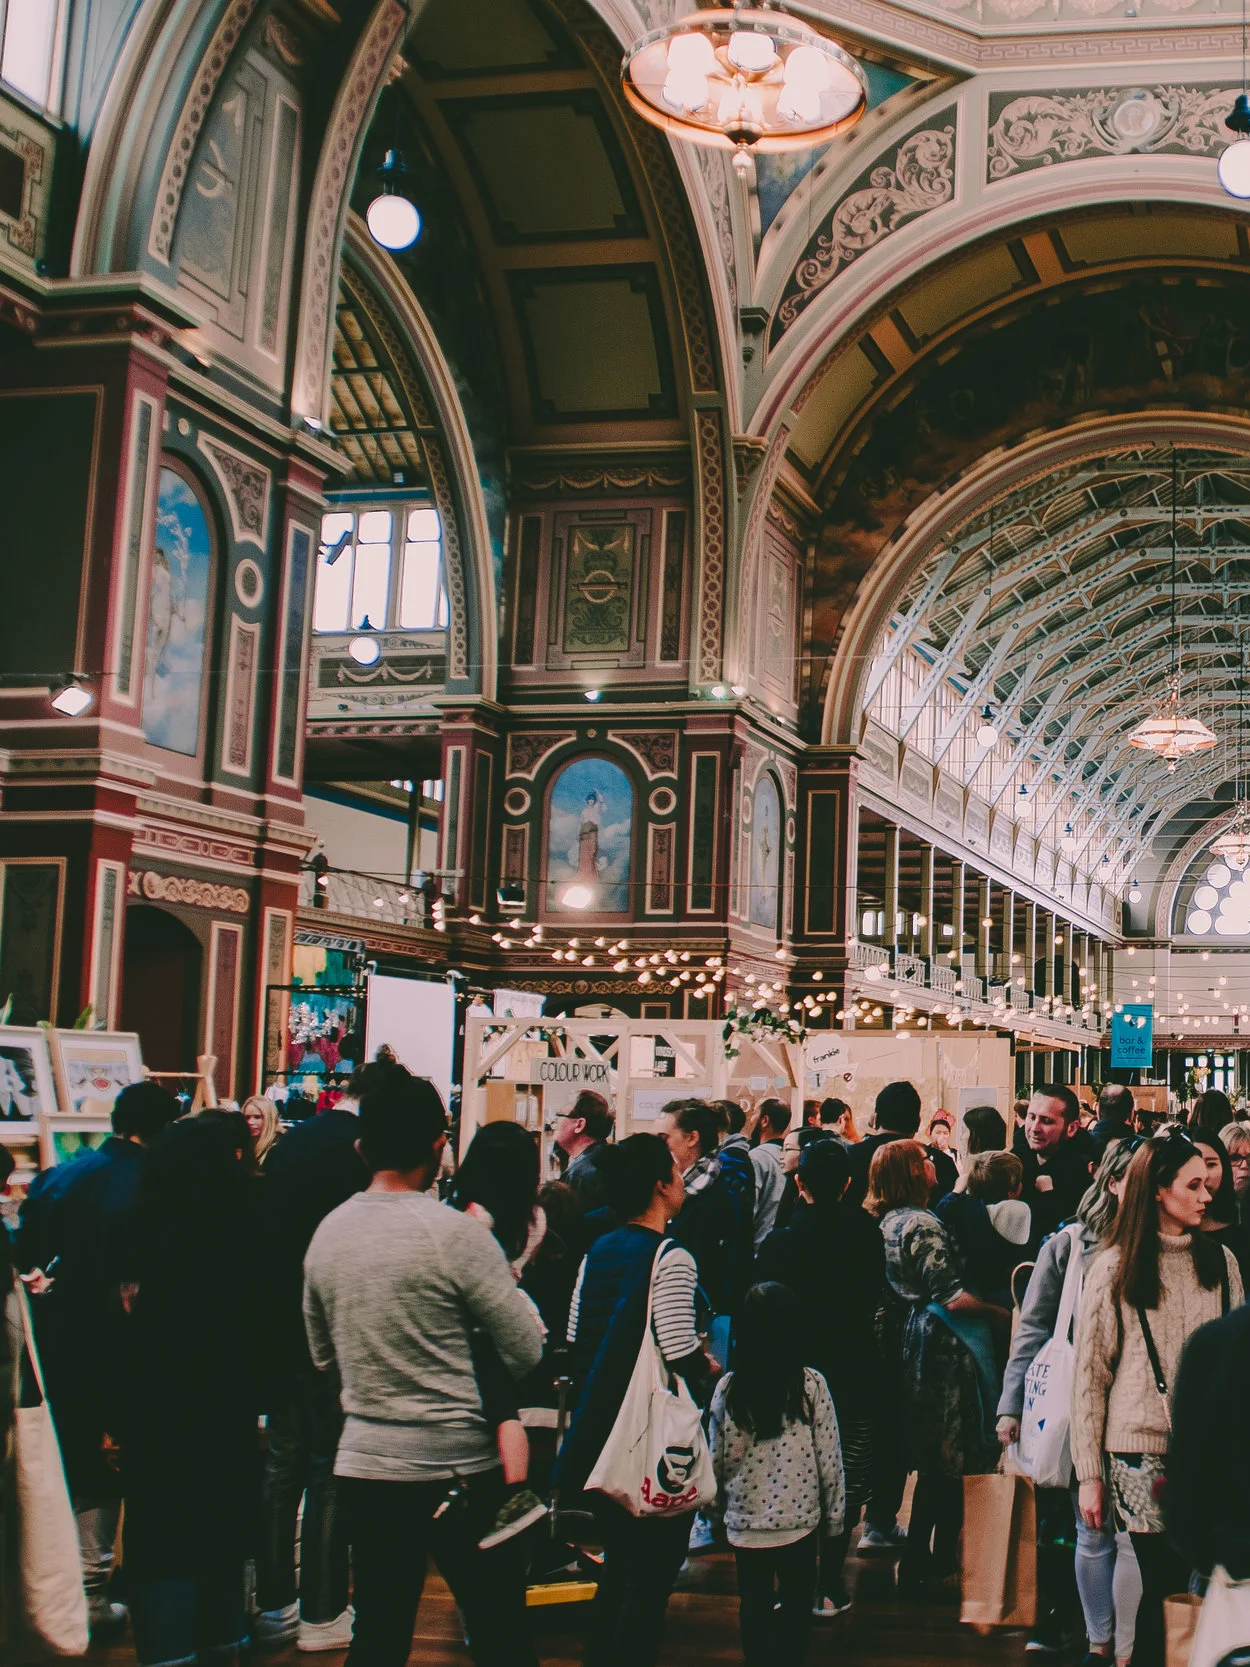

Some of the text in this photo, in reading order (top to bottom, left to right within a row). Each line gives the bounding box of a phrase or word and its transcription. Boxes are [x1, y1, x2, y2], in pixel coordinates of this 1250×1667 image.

[1119, 1035, 1145, 1045] bar &
[812, 1048, 840, 1063] frankie
[1117, 1045, 1146, 1054] coffee
[541, 1062, 610, 1083] COLOUR WORK
